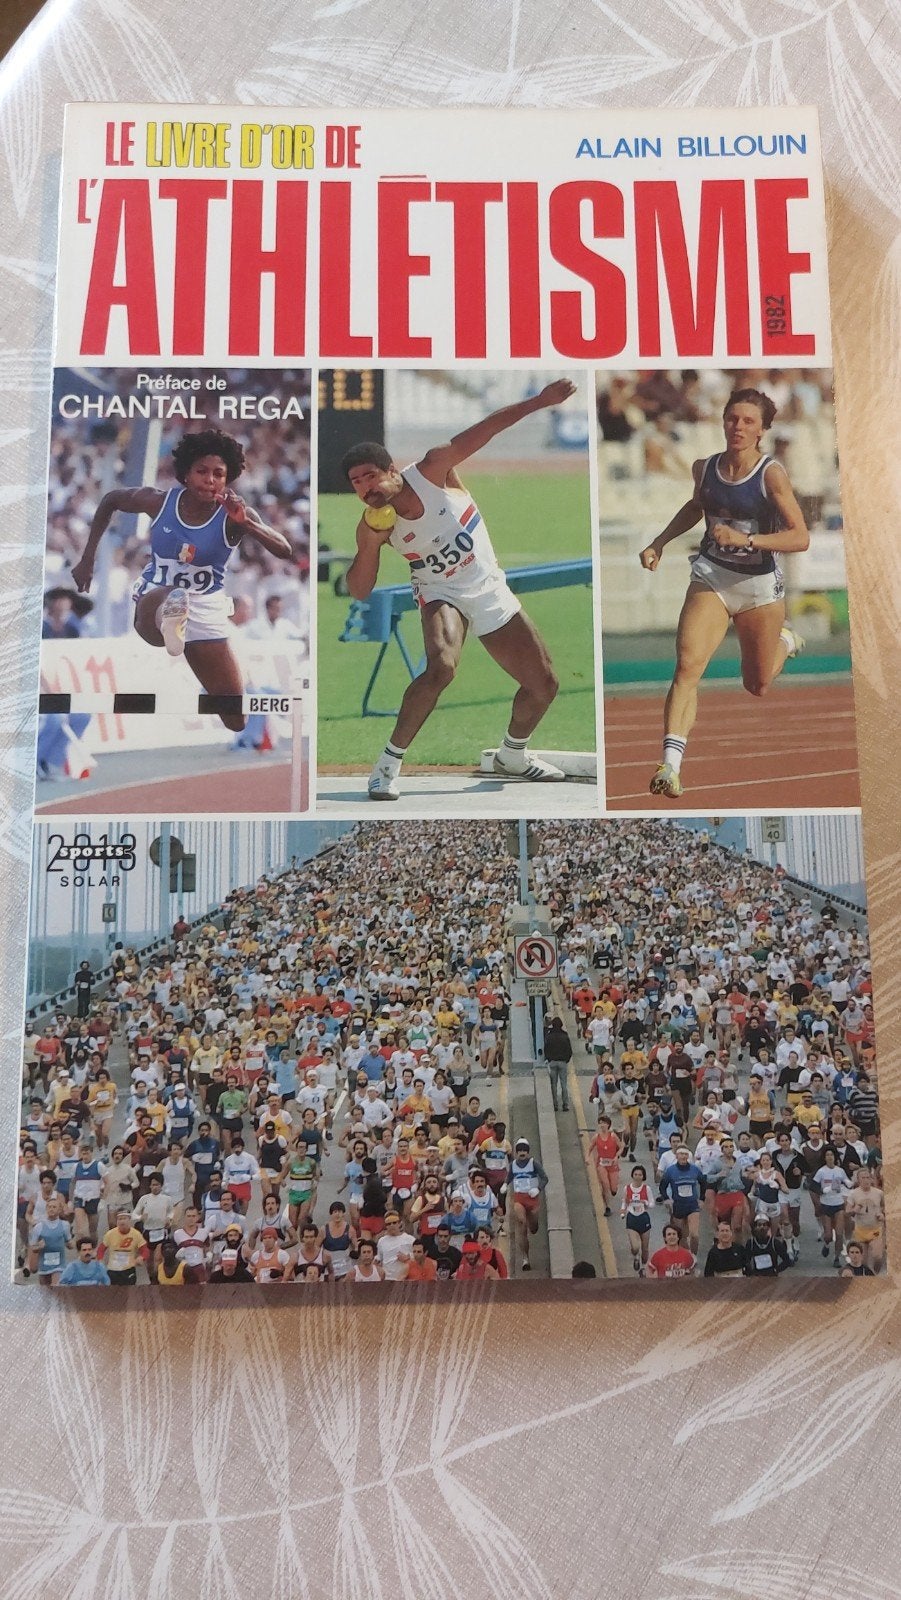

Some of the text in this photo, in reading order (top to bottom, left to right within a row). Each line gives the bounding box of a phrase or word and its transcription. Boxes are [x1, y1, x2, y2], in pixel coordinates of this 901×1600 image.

[105, 121, 362, 169] LE LIVRE D'OR DE
[575, 134, 807, 159] ALAIN BILLOUIN
[765, 295, 786, 337] 1982
[136, 373, 227, 391] Préface de
[58, 394, 305, 421] CHANTAL REGA
[425, 531, 474, 574] 350
[158, 564, 212, 592] 169
[250, 697, 290, 713] BERG
[767, 830, 780, 840] 40
[59, 845, 125, 860] sports
[60, 875, 121, 888] SOLAR
